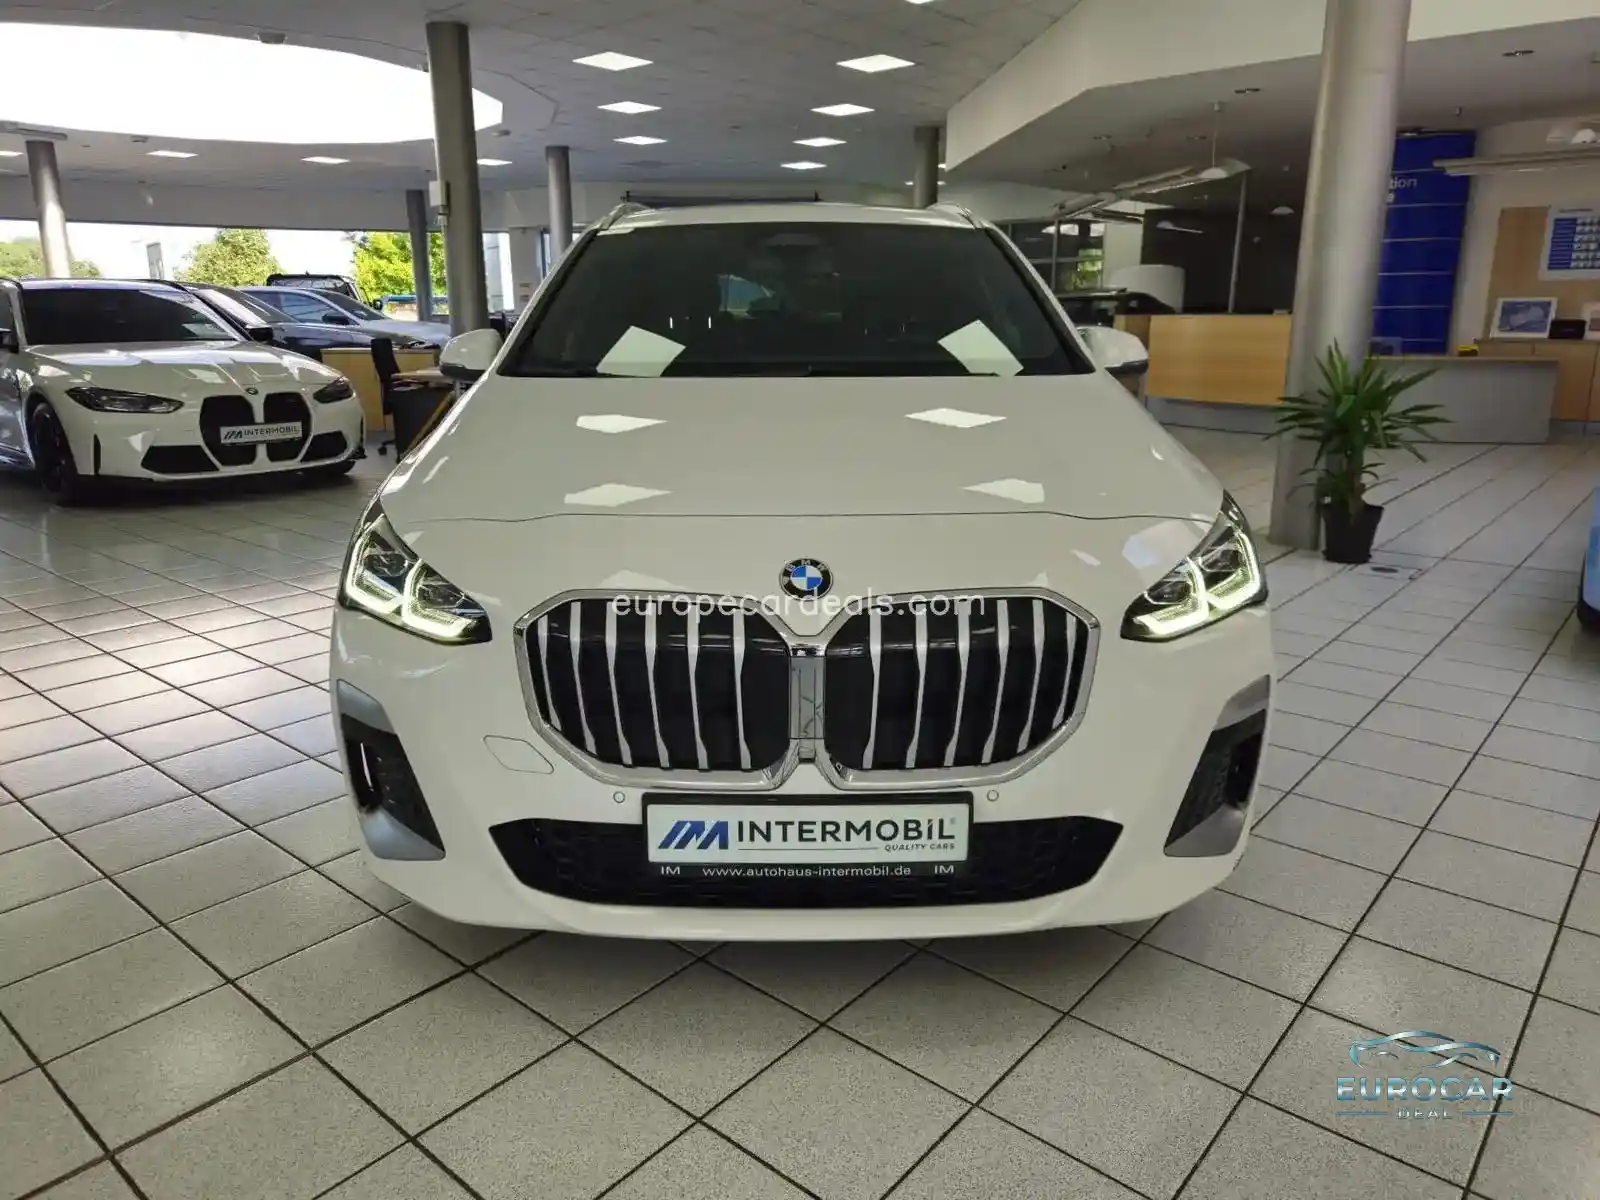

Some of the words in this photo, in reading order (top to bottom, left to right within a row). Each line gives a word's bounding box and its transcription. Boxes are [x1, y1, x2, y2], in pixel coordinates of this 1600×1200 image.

[243, 425, 297, 436] INTERMOBIL
[737, 818, 956, 843] INTERMOBIL
[884, 843, 926, 852] QUALITY
[929, 843, 956, 851] CARS
[661, 866, 681, 875] IM
[702, 865, 912, 877] www.autohaus-intermobil.de
[934, 864, 955, 874] IM
